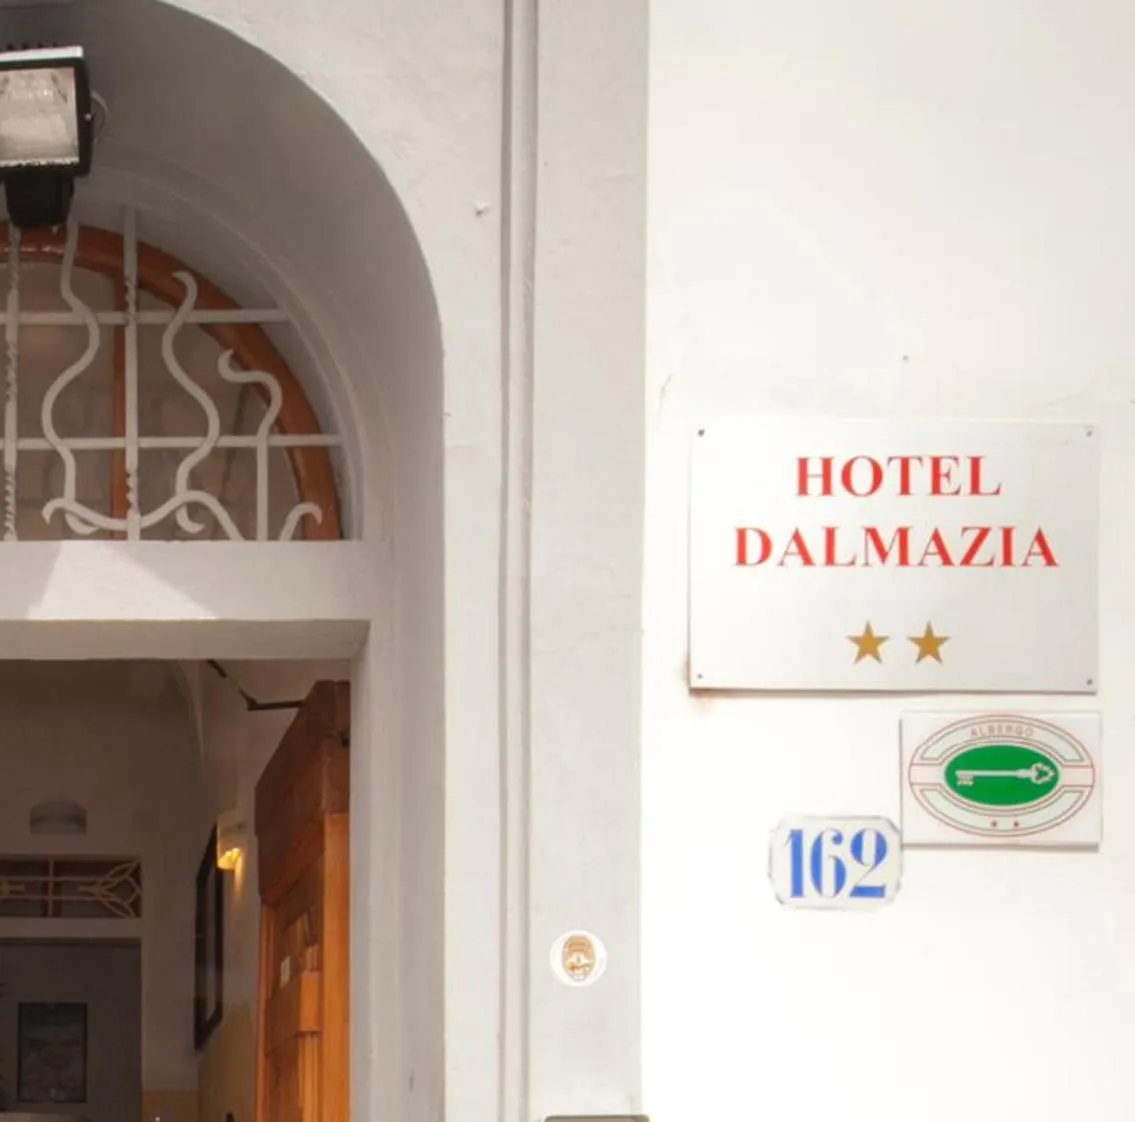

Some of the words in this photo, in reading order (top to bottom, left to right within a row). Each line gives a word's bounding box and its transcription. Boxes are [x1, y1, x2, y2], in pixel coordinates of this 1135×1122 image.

[796, 455, 1002, 497] HOTEL
[734, 526, 1059, 568] DALMAZIA
[970, 724, 1035, 738] ALBERGO
[785, 828, 889, 899] 162
